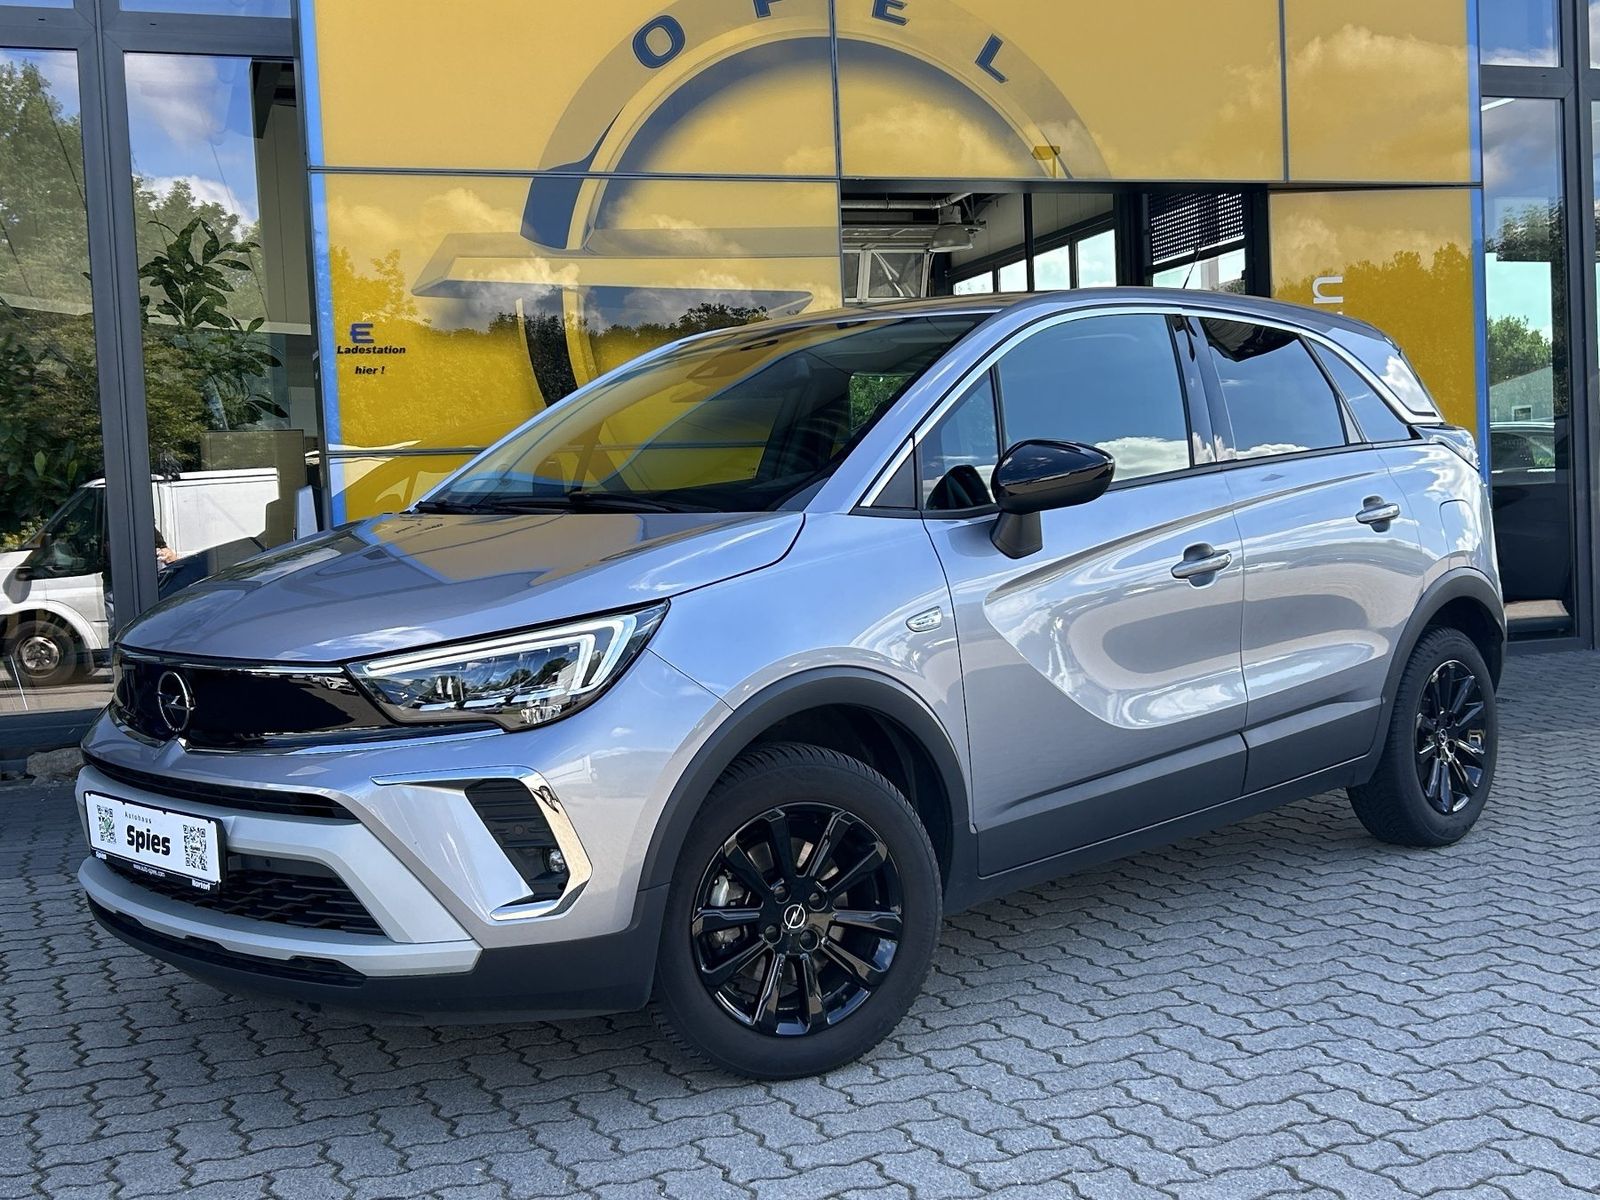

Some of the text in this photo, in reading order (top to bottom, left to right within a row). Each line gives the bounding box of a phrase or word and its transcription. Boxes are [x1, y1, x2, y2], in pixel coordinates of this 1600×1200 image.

[336, 345, 406, 354] Ladestation
[355, 365, 378, 375] hier
[124, 811, 152, 824] Autohaus
[126, 824, 171, 856] Spies
